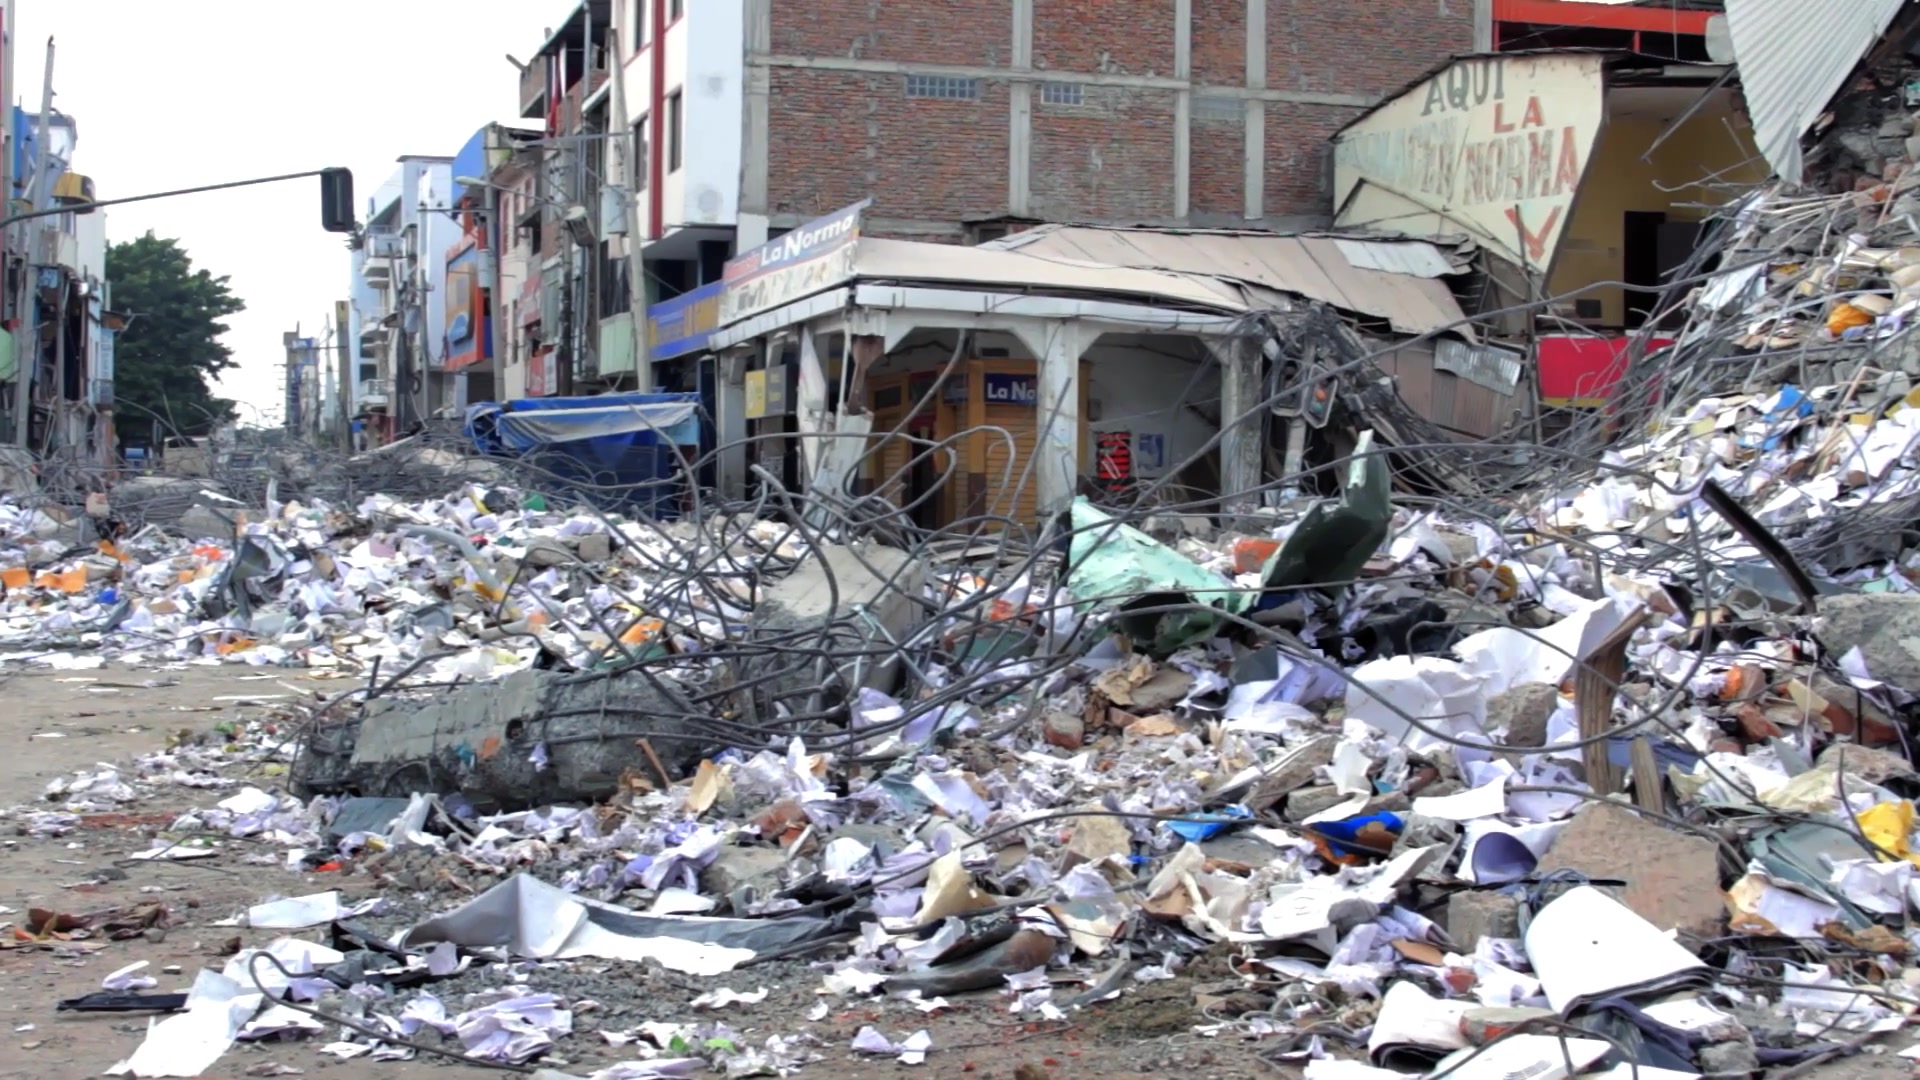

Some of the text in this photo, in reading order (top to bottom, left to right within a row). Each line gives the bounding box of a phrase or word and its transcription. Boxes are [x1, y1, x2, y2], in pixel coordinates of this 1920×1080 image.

[1422, 60, 1505, 116] AQUI
[1493, 96, 1545, 134] LA
[1463, 126, 1578, 206] NORMA
[760, 215, 854, 265] La Norma
[987, 383, 1007, 399] La
